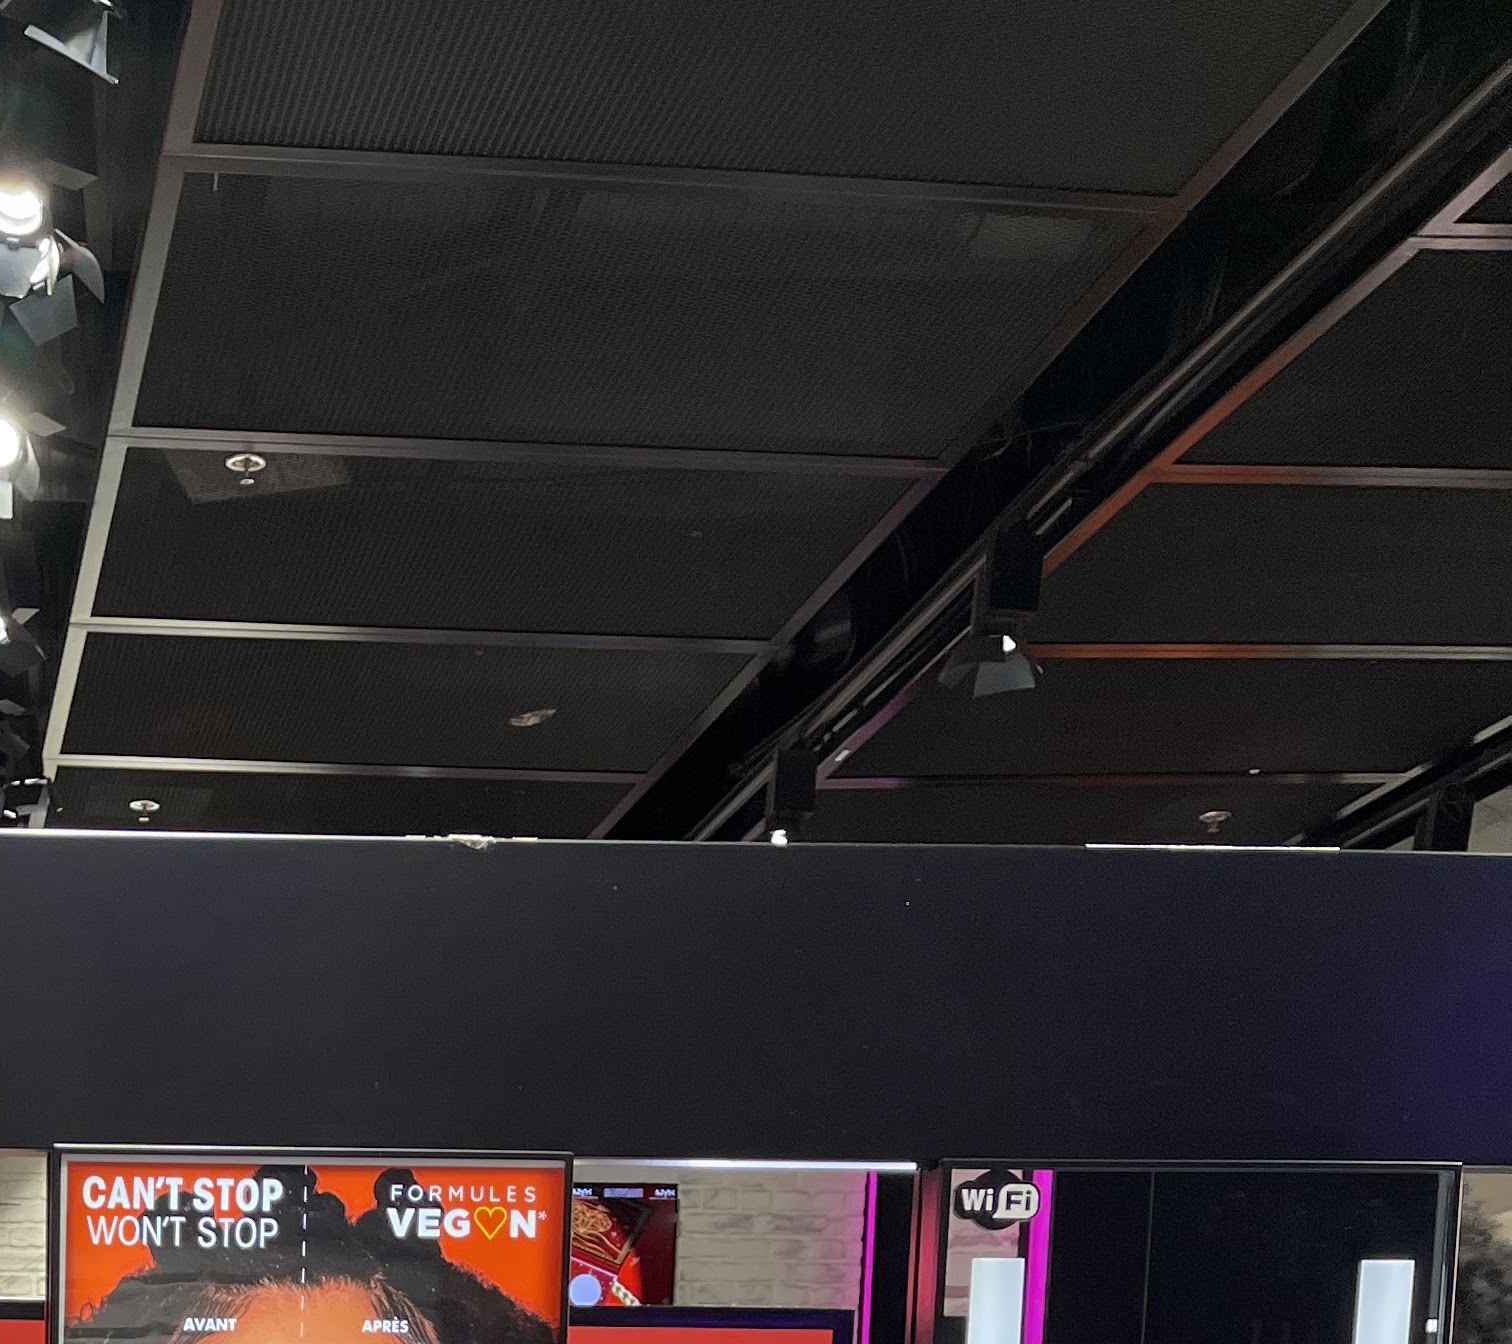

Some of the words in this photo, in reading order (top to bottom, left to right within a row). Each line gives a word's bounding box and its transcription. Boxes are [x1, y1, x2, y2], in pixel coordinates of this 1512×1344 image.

[83, 1176, 180, 1211] CAN'T
[192, 1177, 284, 1212] STOP
[391, 1184, 537, 1203] FORMULES
[961, 1187, 1032, 1212] WiFi
[87, 1215, 185, 1247] WON'T
[197, 1216, 280, 1249] STOP
[183, 1317, 237, 1333] AVANT
[361, 1315, 410, 1334] APRÈS
